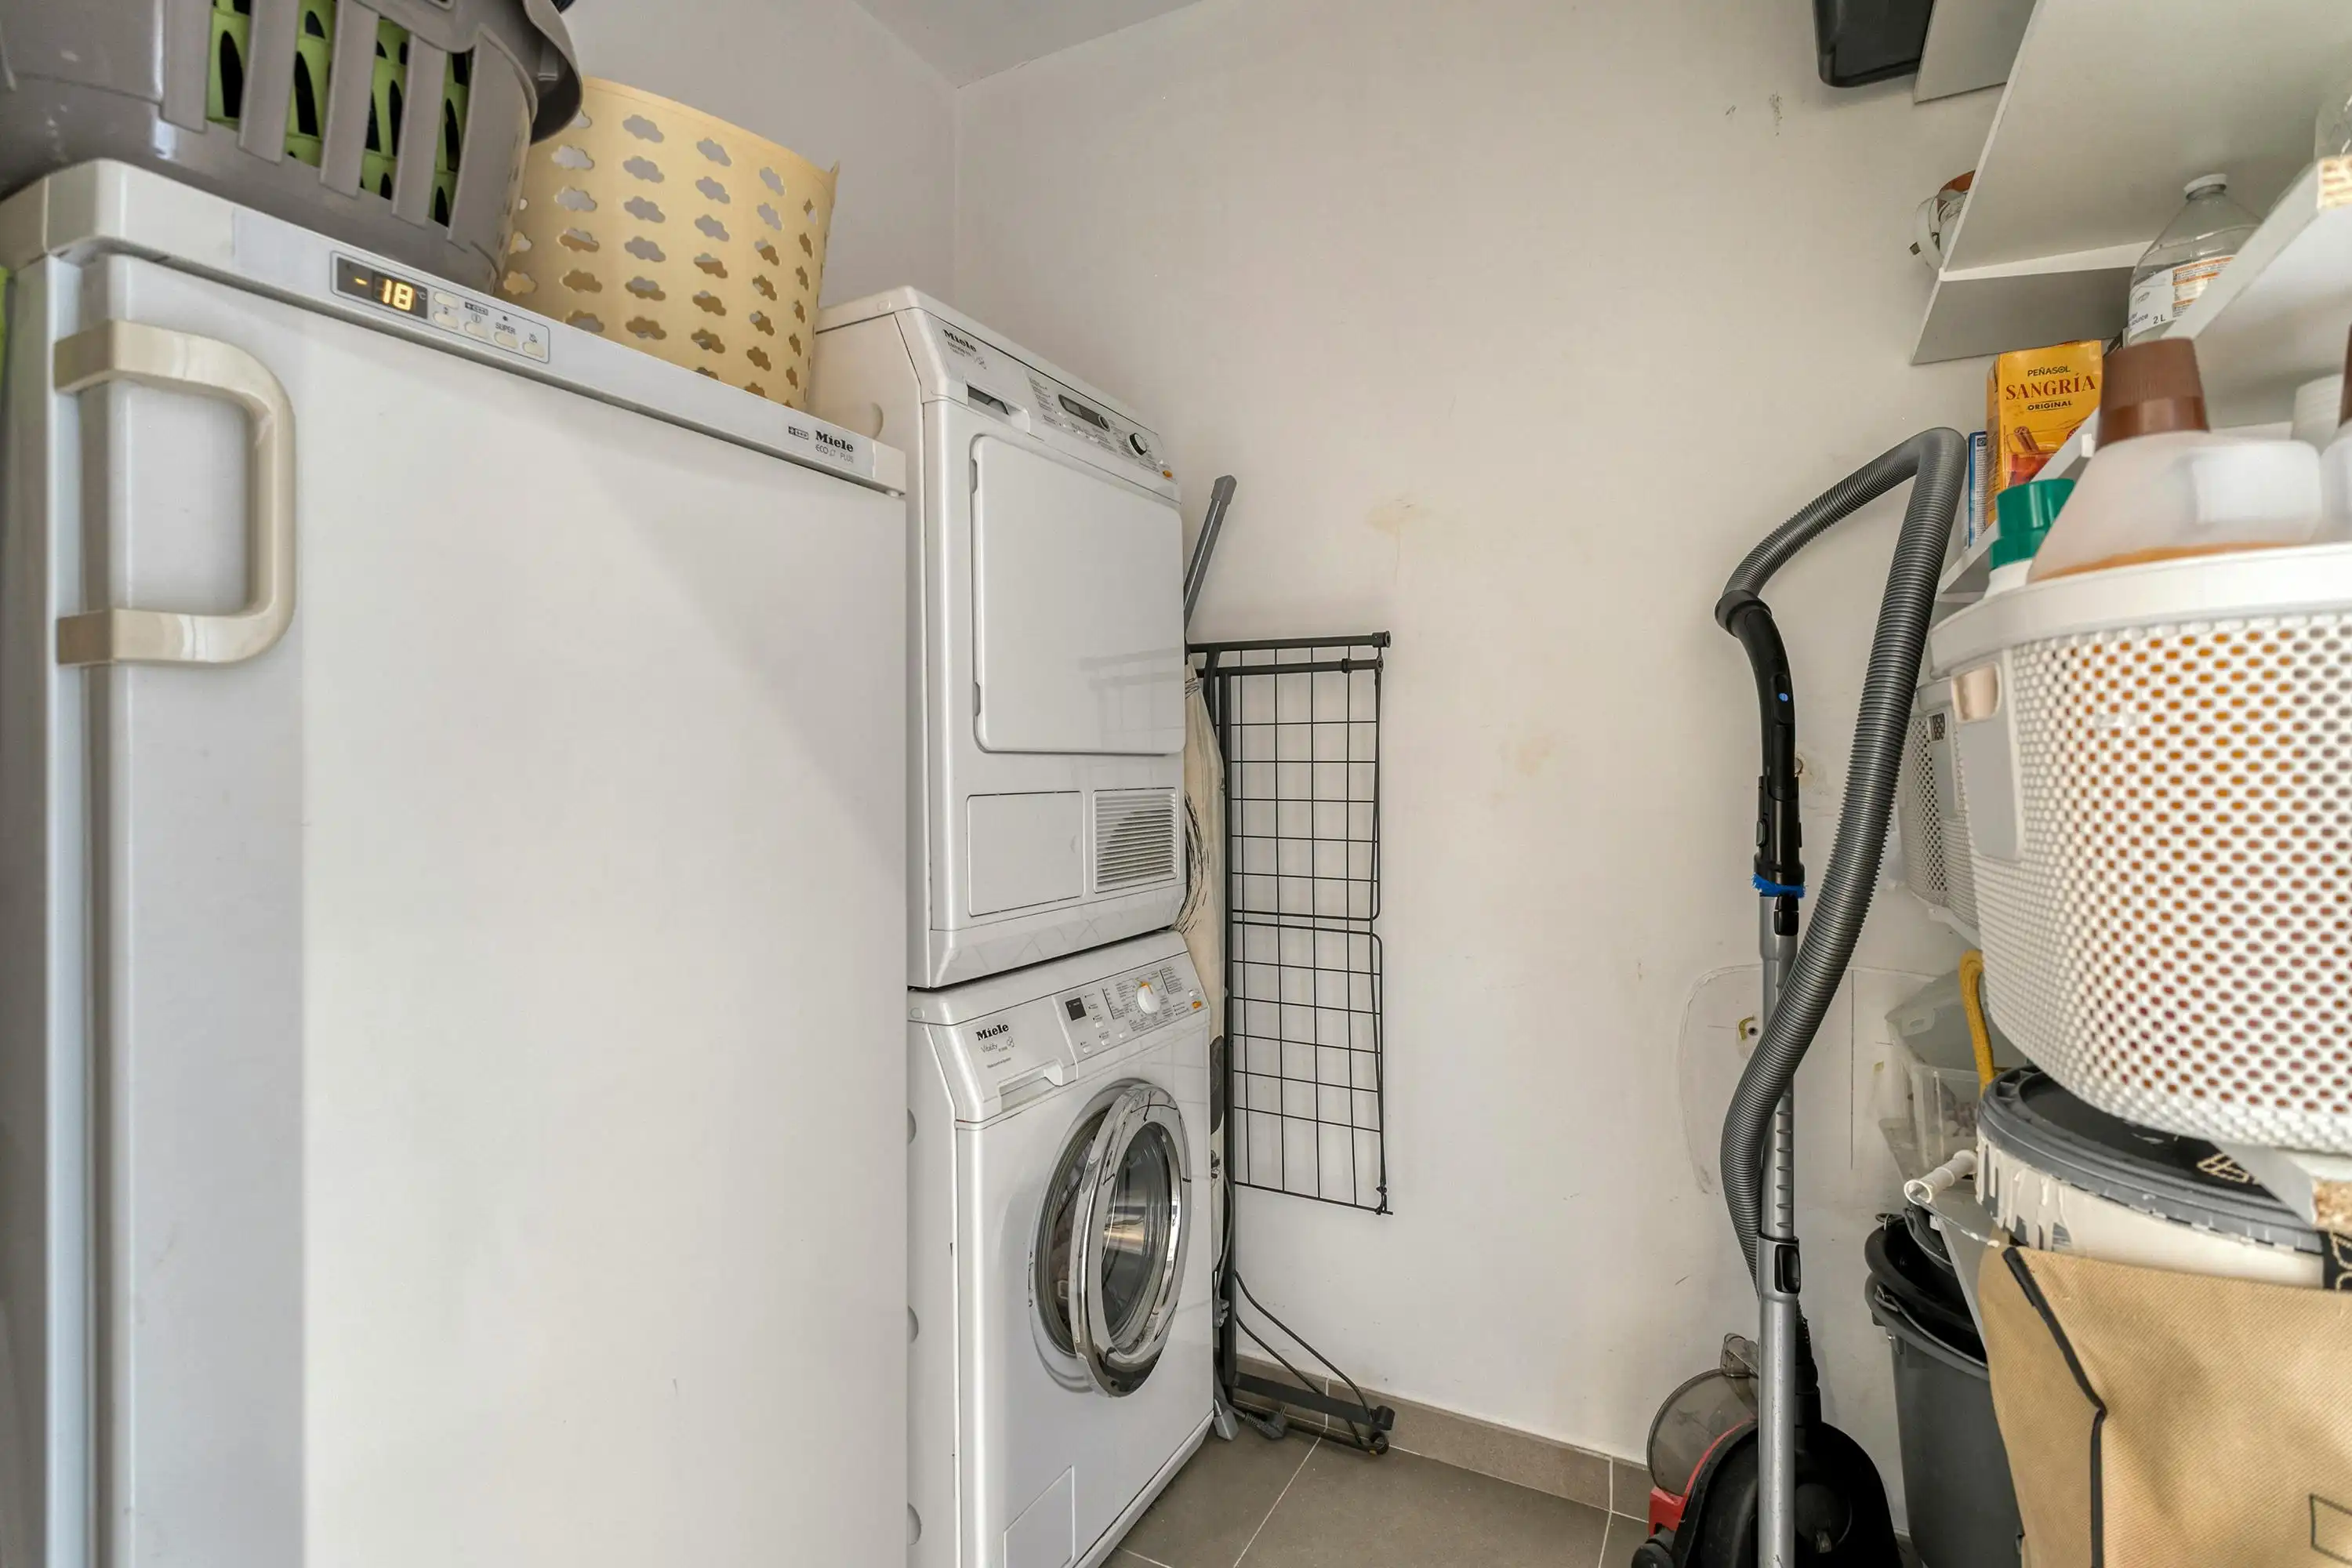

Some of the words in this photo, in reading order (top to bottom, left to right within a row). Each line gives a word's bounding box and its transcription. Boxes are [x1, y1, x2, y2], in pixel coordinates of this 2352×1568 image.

[495, 321, 516, 335] SUPER
[943, 328, 977, 352] Miele
[2027, 364, 2071, 377] PEÑASOL
[2005, 372, 2096, 401] SANGRÍA
[2027, 400, 2073, 411] ORIGINAL
[815, 430, 855, 452] Miele
[840, 452, 855, 463] PLUS
[976, 1023, 1010, 1041] Miele
